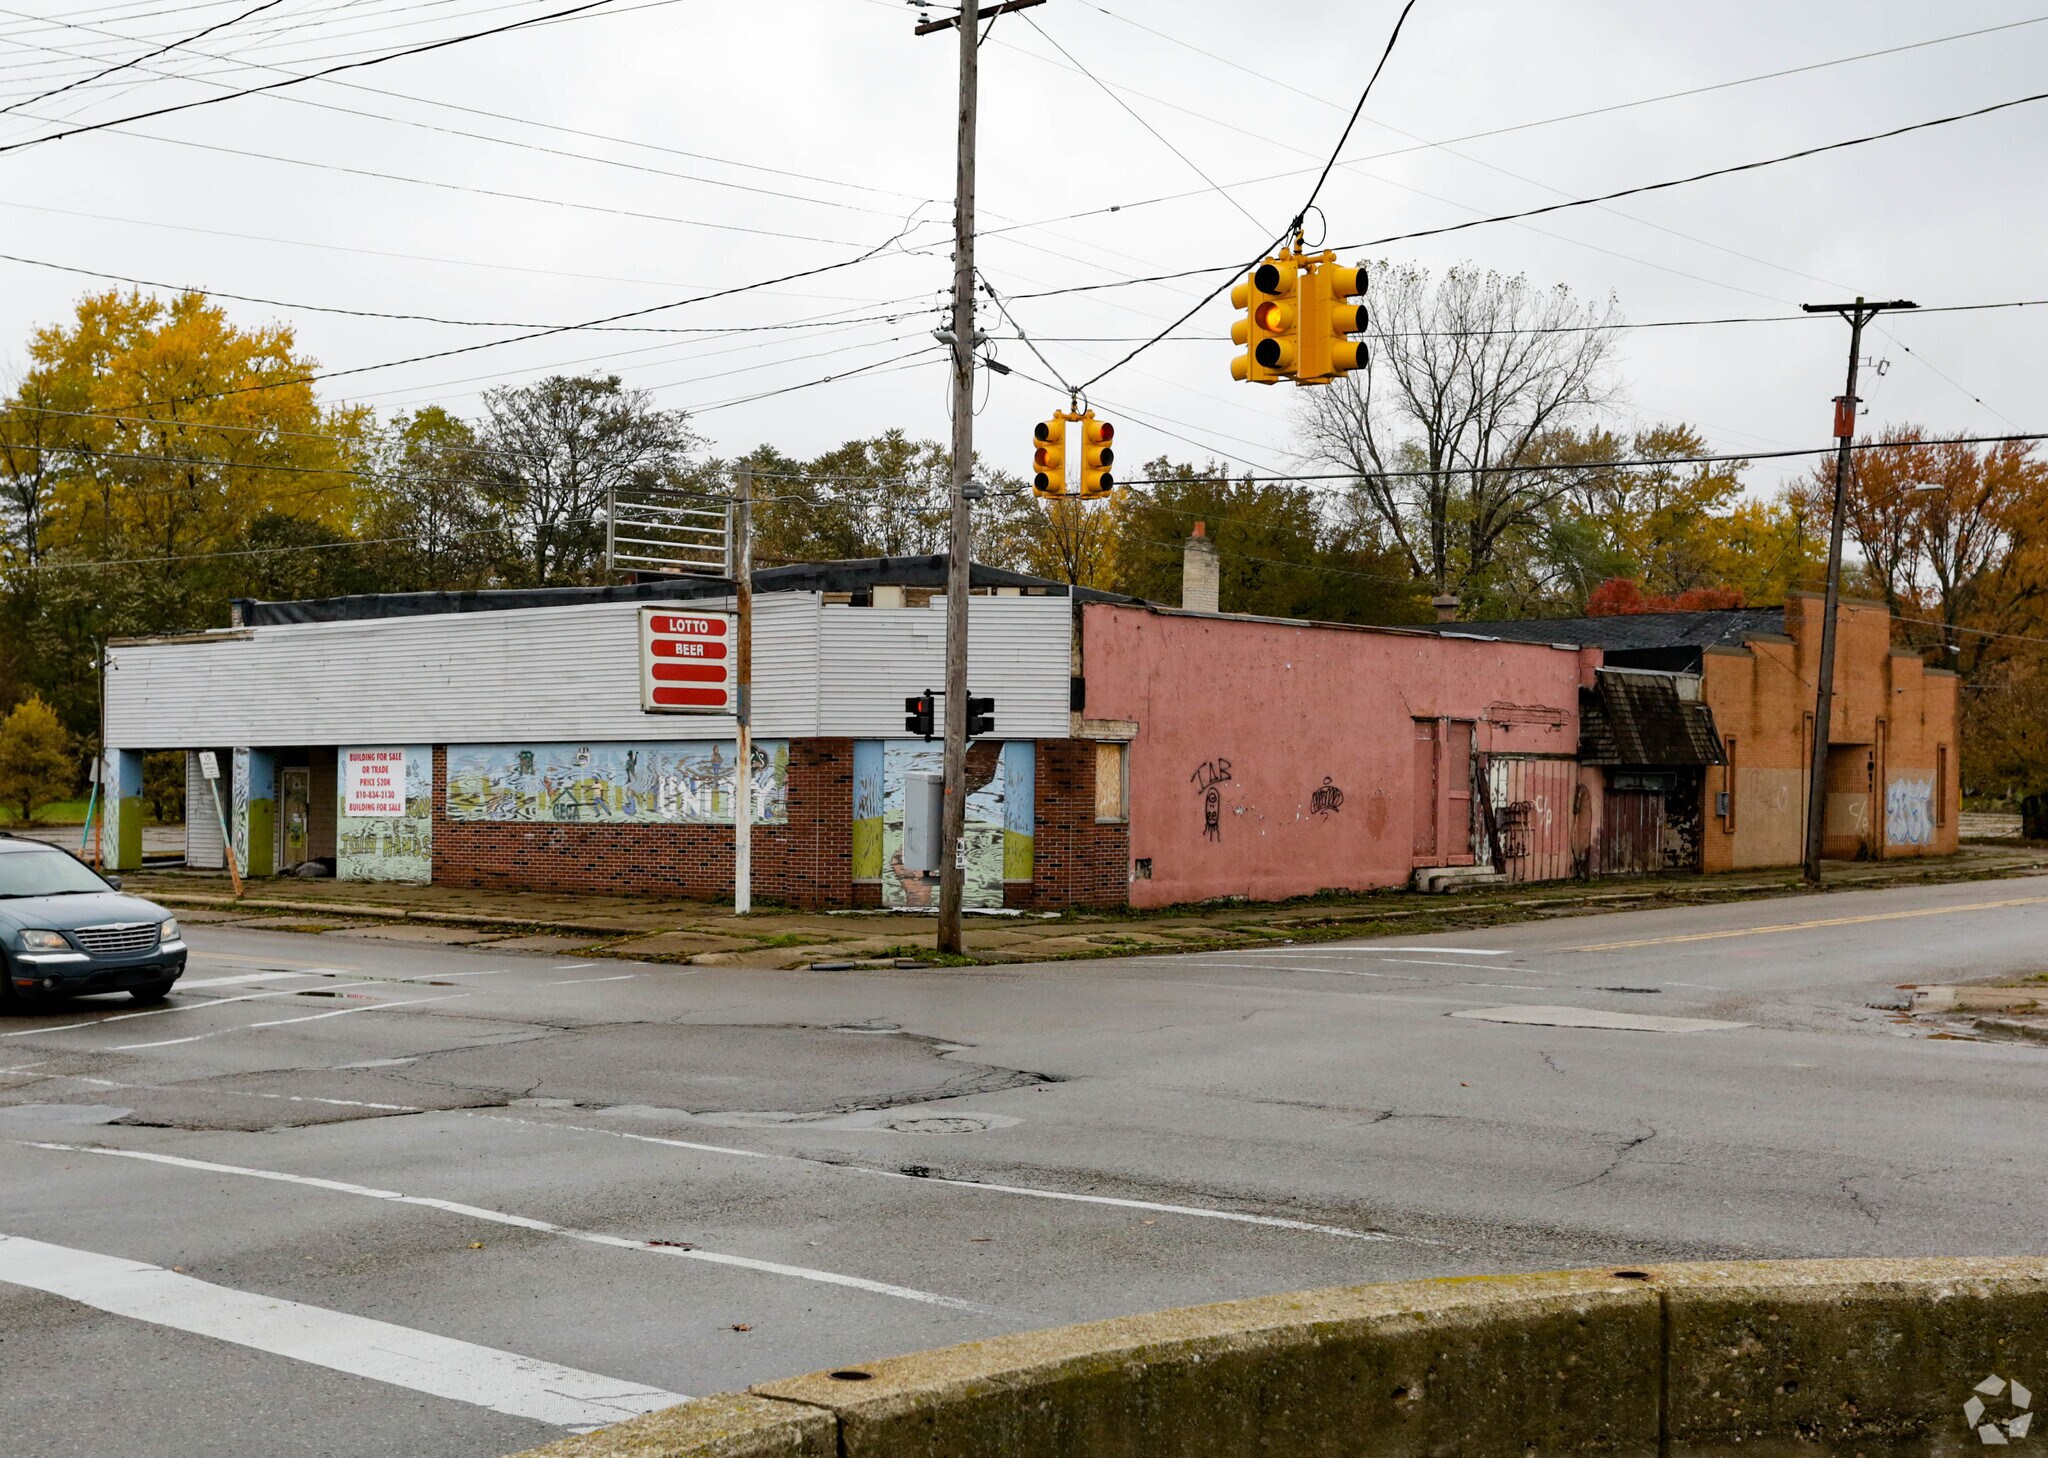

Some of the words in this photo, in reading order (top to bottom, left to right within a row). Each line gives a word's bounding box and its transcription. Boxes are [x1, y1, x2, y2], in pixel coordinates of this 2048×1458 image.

[669, 618, 709, 634] LOTTO
[675, 642, 705, 657] BEER
[349, 753, 375, 762] BUILDING
[376, 753, 387, 761] FOR
[388, 752, 402, 761] SALE
[361, 765, 370, 774] OR
[371, 765, 389, 774] TRADE
[359, 778, 375, 787] PRICE
[376, 777, 391, 787] $20K
[355, 790, 395, 799] 810-834-2130
[349, 803, 375, 812] BUILDING
[376, 803, 387, 811] FOR
[388, 803, 401, 811] SALE
[339, 833, 377, 856] JOIN
[382, 833, 432, 860] HANDS
